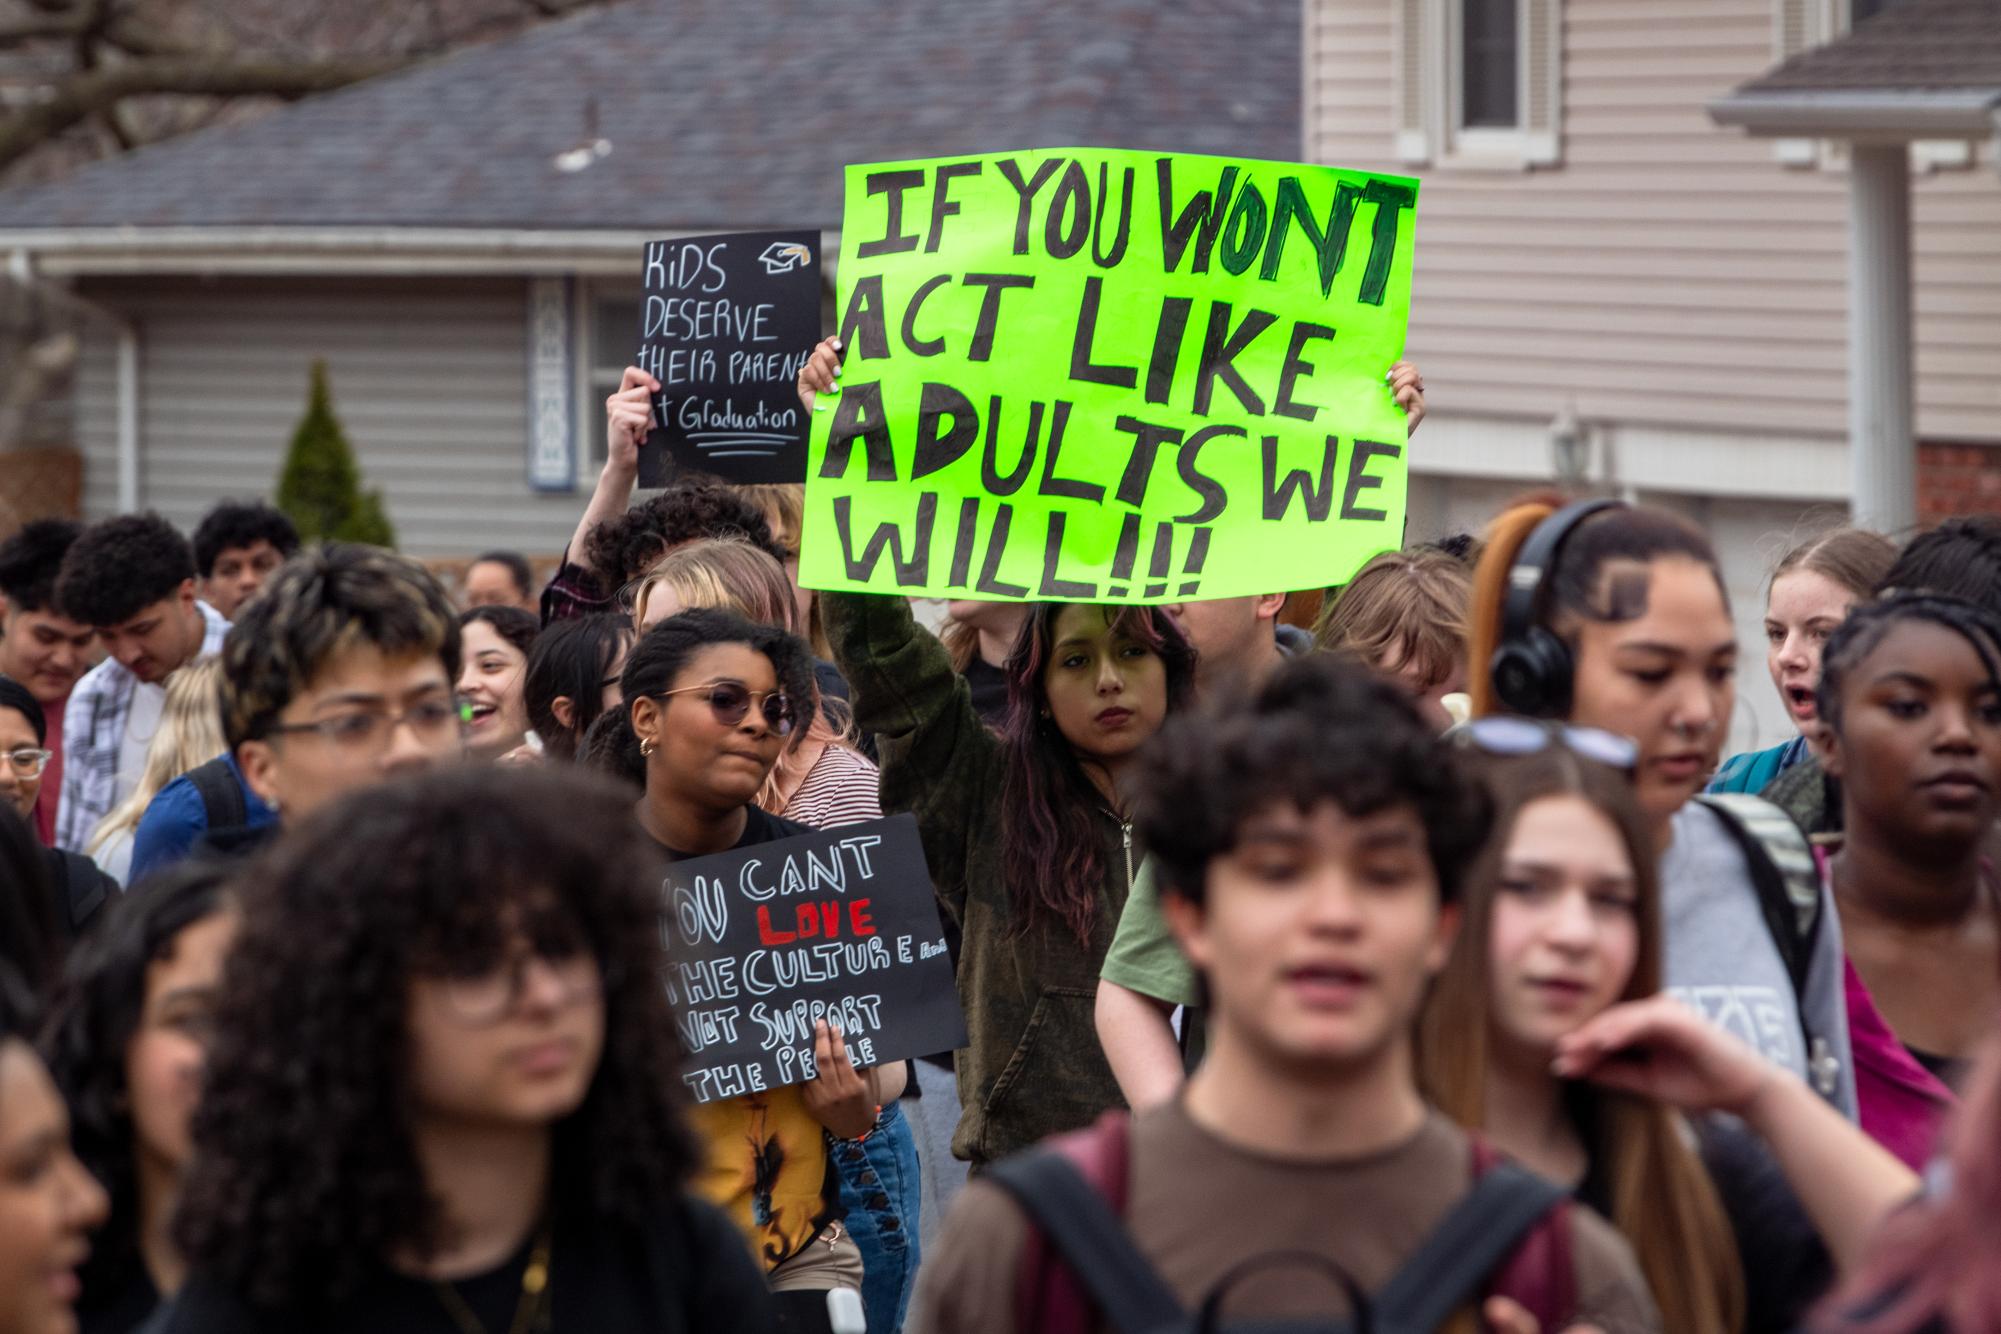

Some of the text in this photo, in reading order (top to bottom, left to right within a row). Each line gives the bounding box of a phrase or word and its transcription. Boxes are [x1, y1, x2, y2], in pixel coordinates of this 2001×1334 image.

[857, 158, 1416, 305] IF YOU WONT
[644, 295, 779, 342] DESERVE
[841, 274, 1337, 422] ACT LIKE
[678, 395, 797, 430] Graduation
[819, 379, 1401, 525] ADULTS WE
[833, 491, 1213, 598] WILL!!!
[739, 834, 881, 901] CANT
[756, 898, 877, 946] LOVE
[660, 956, 739, 1005] THE
[742, 934, 914, 996] CULTURE
[749, 994, 882, 1051] SUPPORT
[683, 1037, 877, 1103] THE PELE
